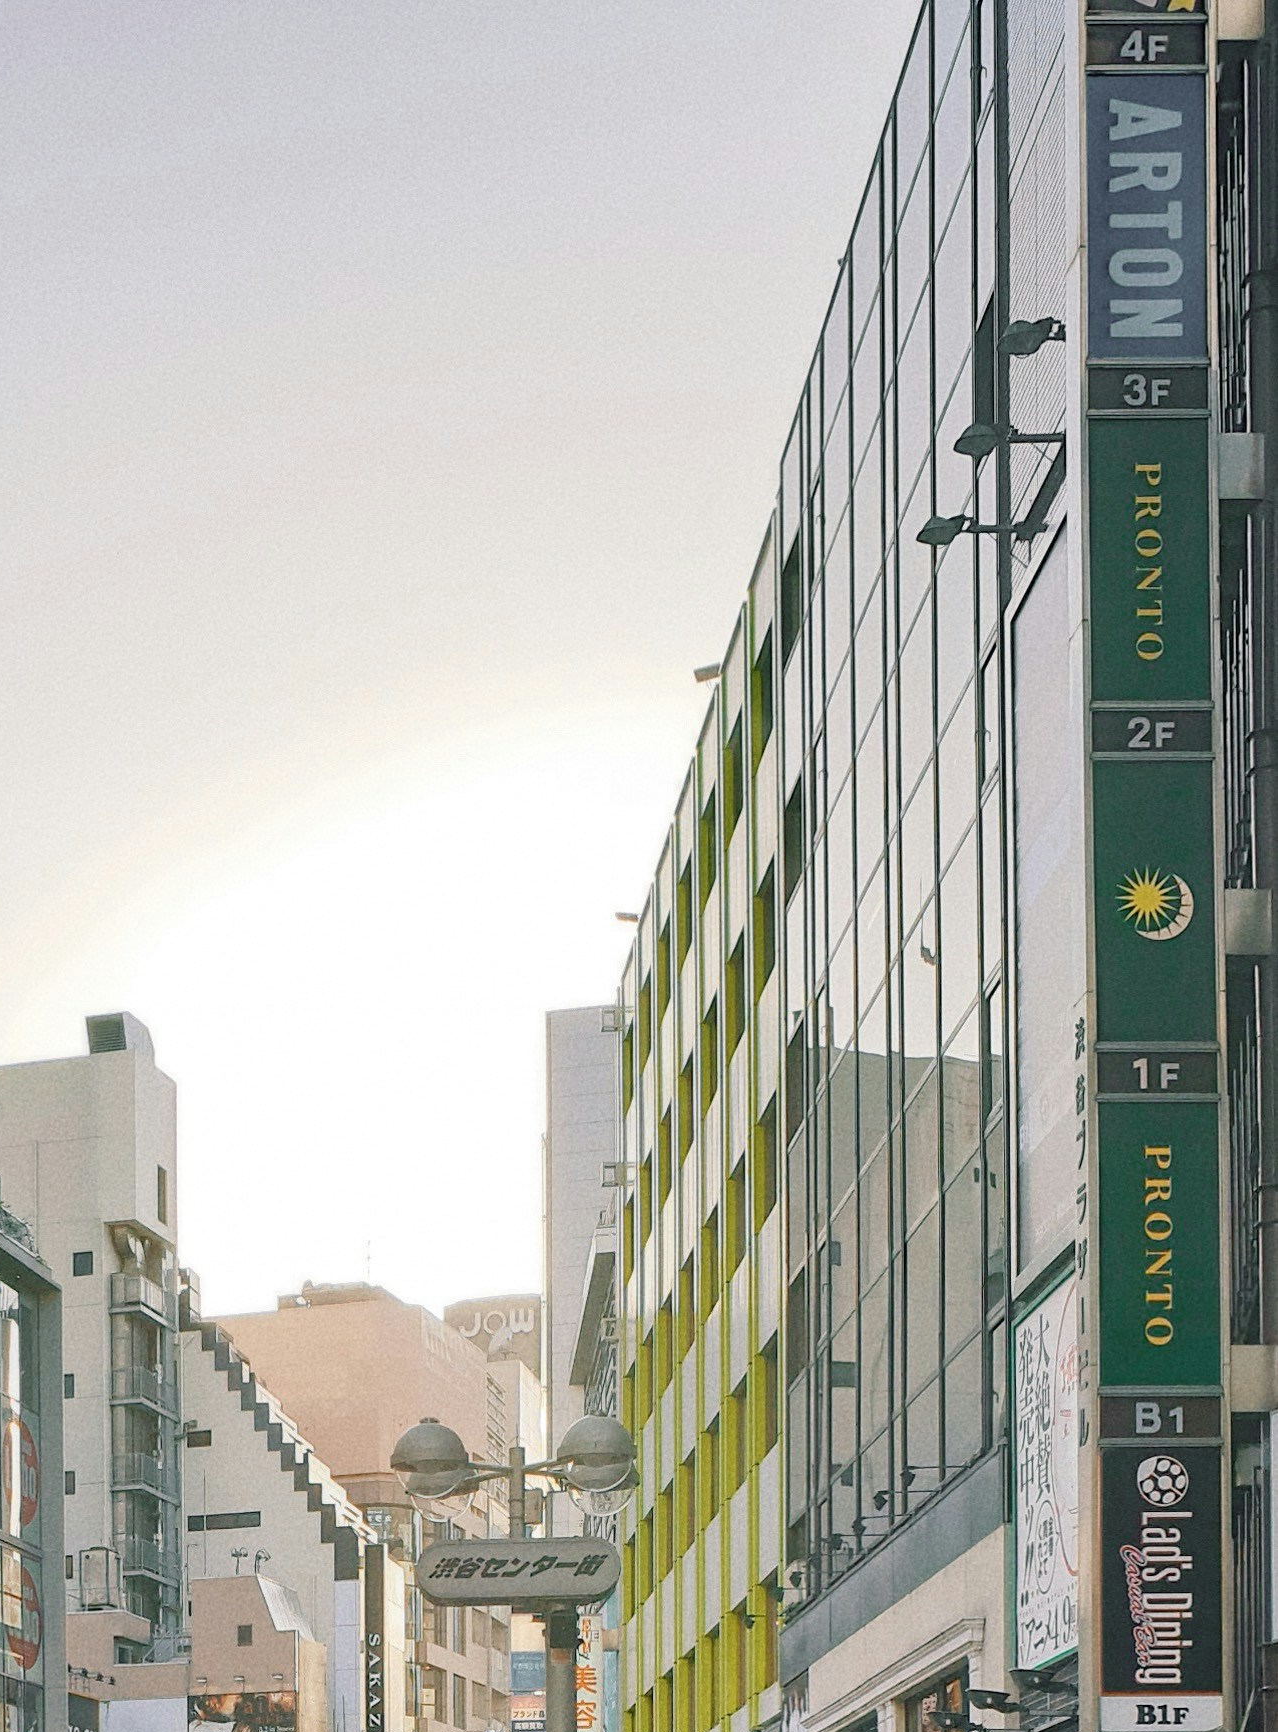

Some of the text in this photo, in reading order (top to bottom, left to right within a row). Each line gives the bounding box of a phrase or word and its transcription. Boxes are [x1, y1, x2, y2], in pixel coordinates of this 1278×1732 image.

[1120, 30, 1169, 61] 4F
[1108, 98, 1184, 339] ARTON
[1122, 374, 1171, 406] 3F
[1134, 462, 1164, 661] PRONTO
[1126, 715, 1175, 748] 2F
[1133, 1057, 1181, 1090] 1F
[1142, 1145, 1174, 1346] PRONTO
[1135, 1402, 1185, 1434] B1
[428, 1554, 609, 1580] 渋谷センター街
[1120, 1544, 1159, 1666] Casual Bar
[1135, 1511, 1193, 1684] Lad's Dining
[1135, 1704, 1190, 1725] B1F
